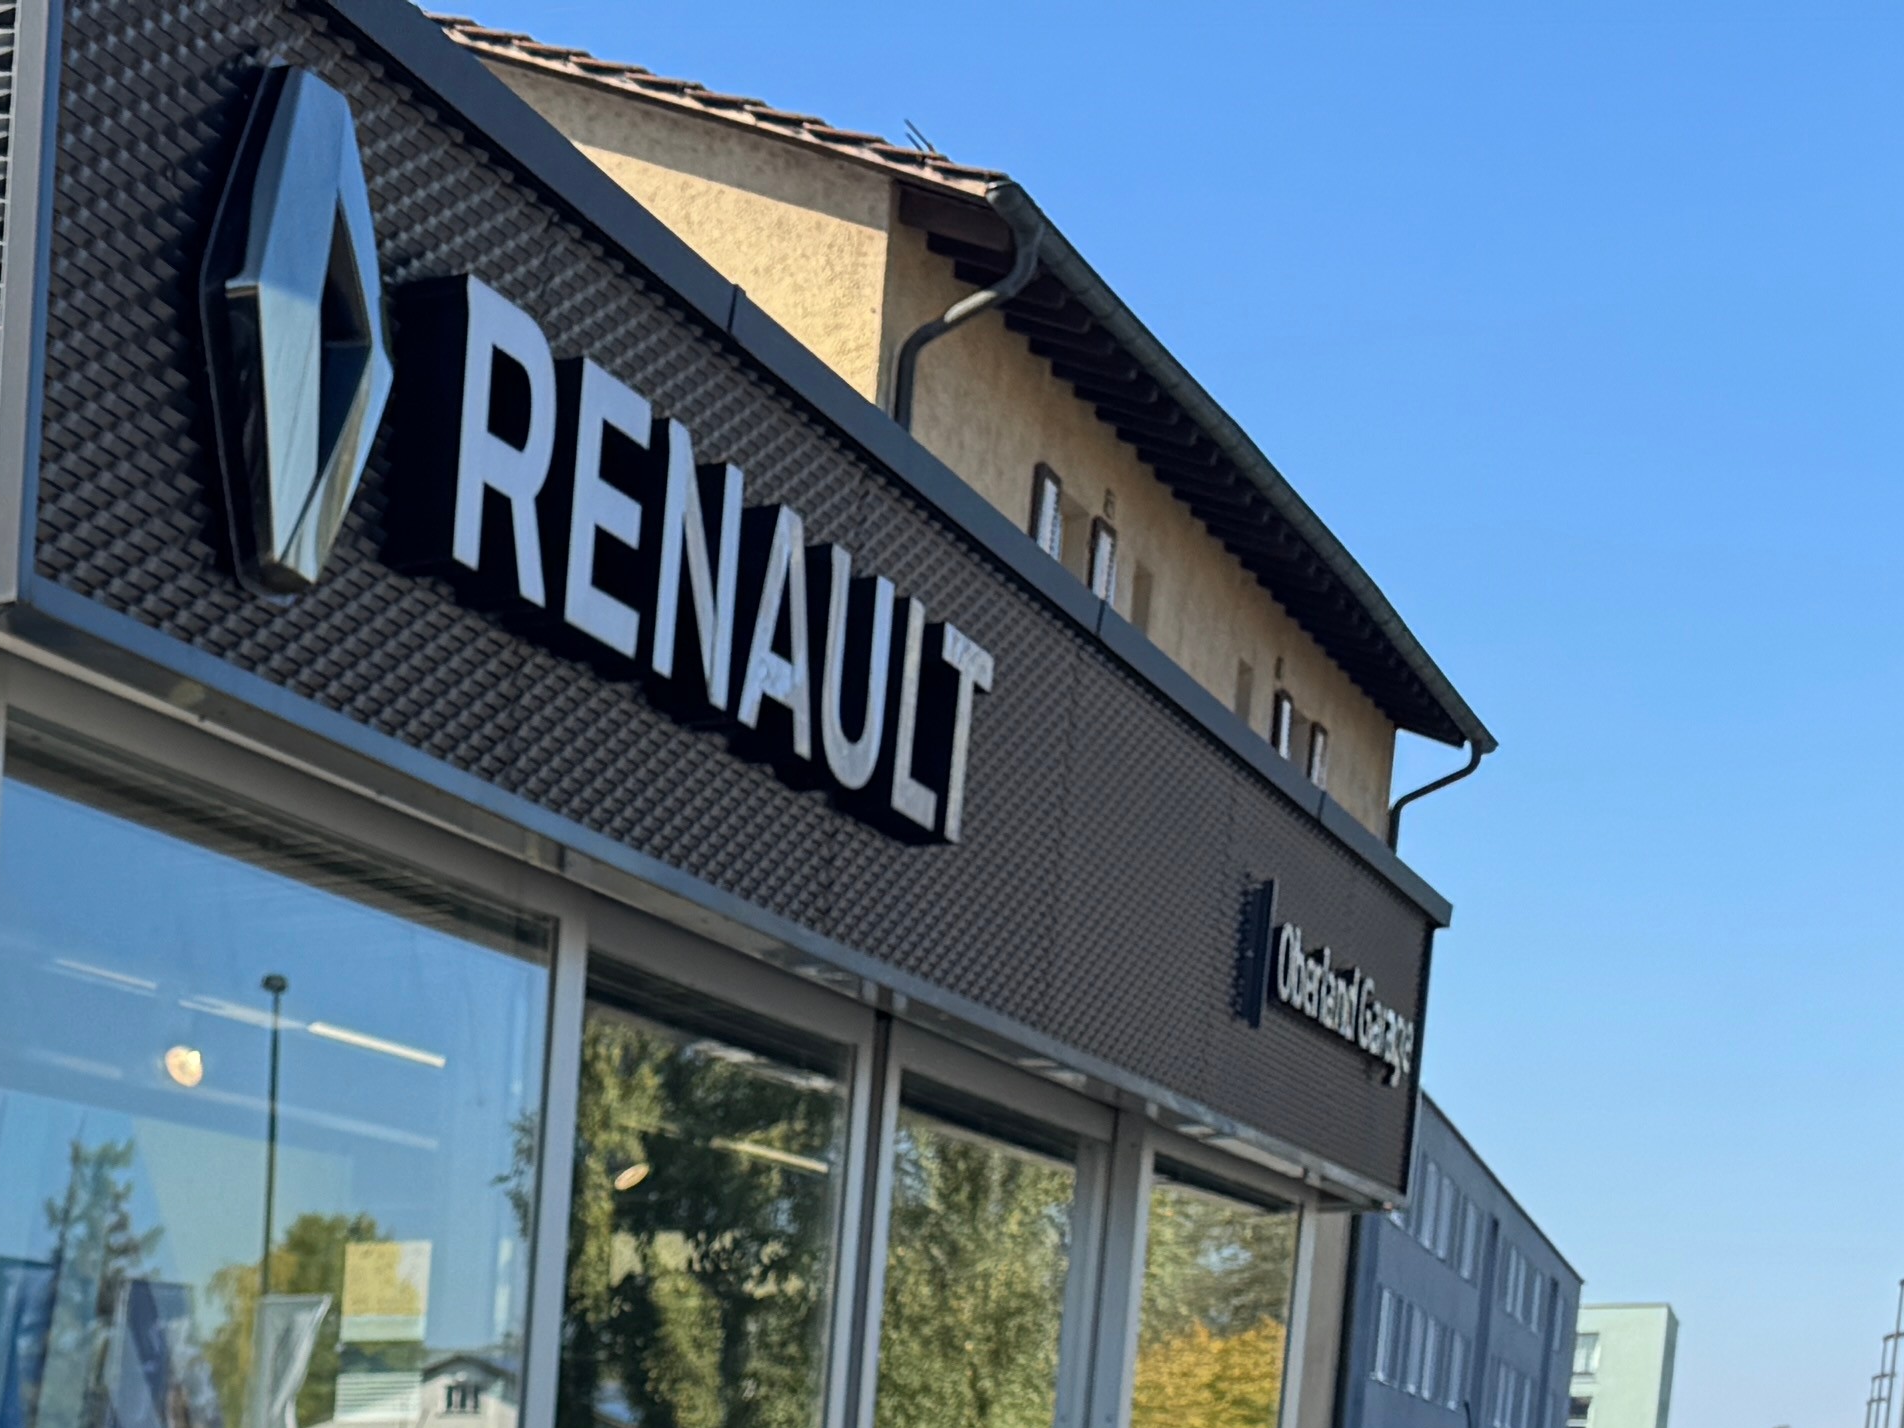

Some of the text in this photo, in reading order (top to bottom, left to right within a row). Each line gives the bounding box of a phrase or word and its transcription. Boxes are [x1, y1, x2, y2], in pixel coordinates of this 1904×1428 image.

[453, 273, 993, 843] RENAULT
[1277, 921, 1414, 1087] Oberland Garage
